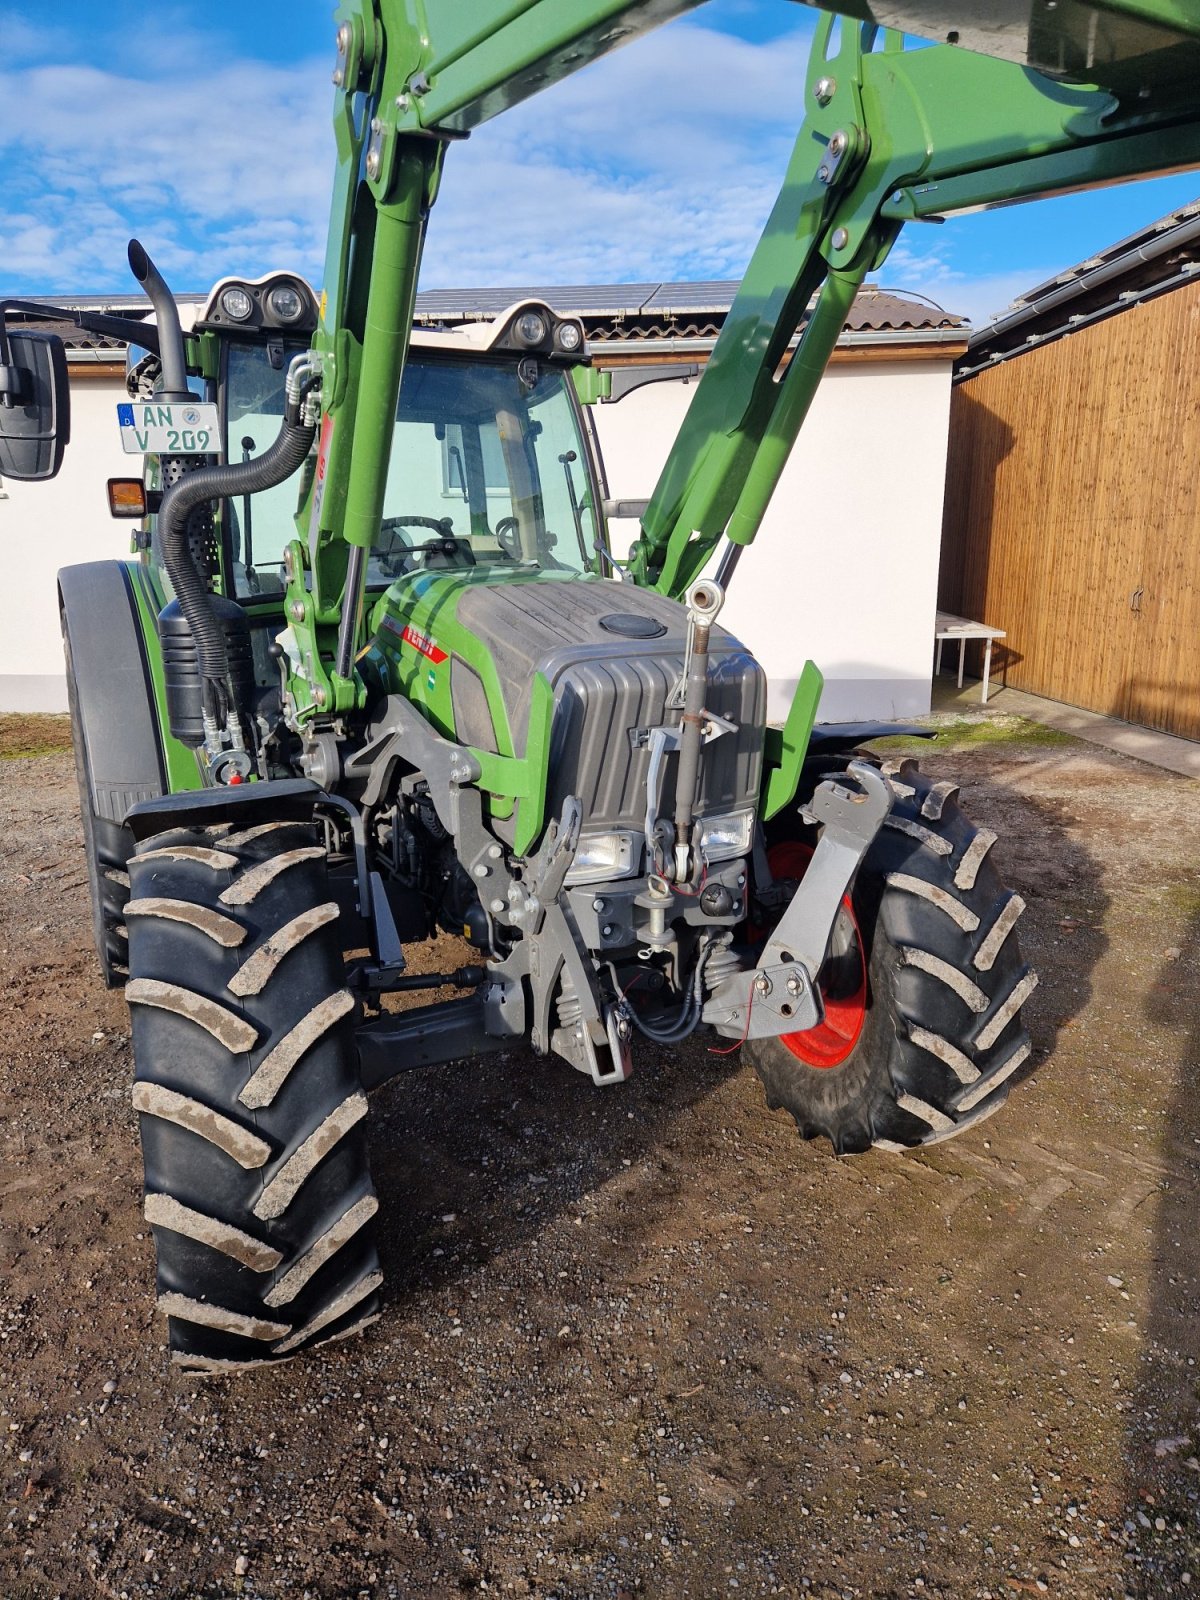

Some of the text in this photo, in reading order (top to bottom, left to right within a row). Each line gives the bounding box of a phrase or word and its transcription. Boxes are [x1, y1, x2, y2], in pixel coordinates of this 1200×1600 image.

[124, 418, 131, 426] D
[143, 406, 173, 427] AN
[135, 430, 210, 451] V 209
[407, 621, 438, 656] FENDT
